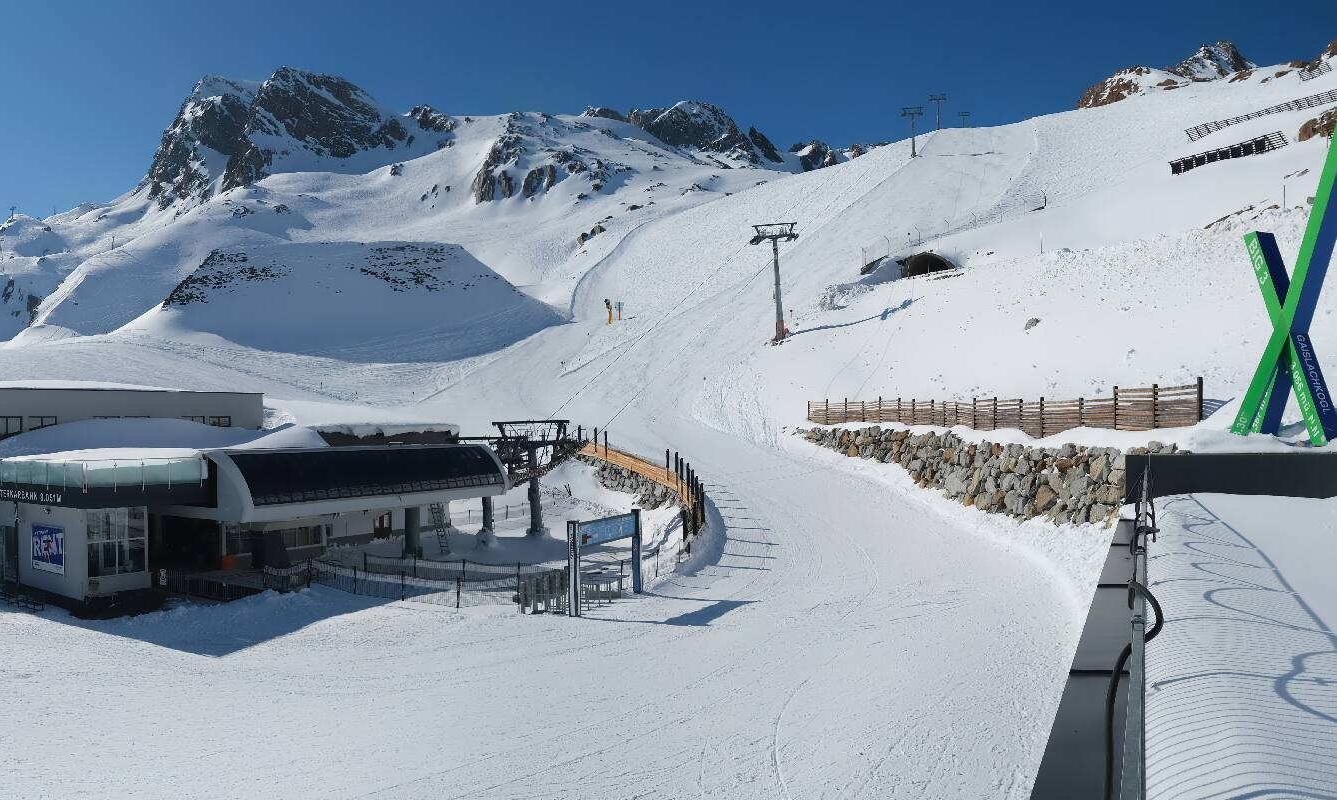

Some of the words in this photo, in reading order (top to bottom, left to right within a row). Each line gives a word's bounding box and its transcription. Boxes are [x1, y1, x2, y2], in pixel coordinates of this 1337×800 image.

[1248, 238, 1263, 271] BIG
[1259, 272, 1268, 285] 3
[33, 533, 64, 557] RENT
